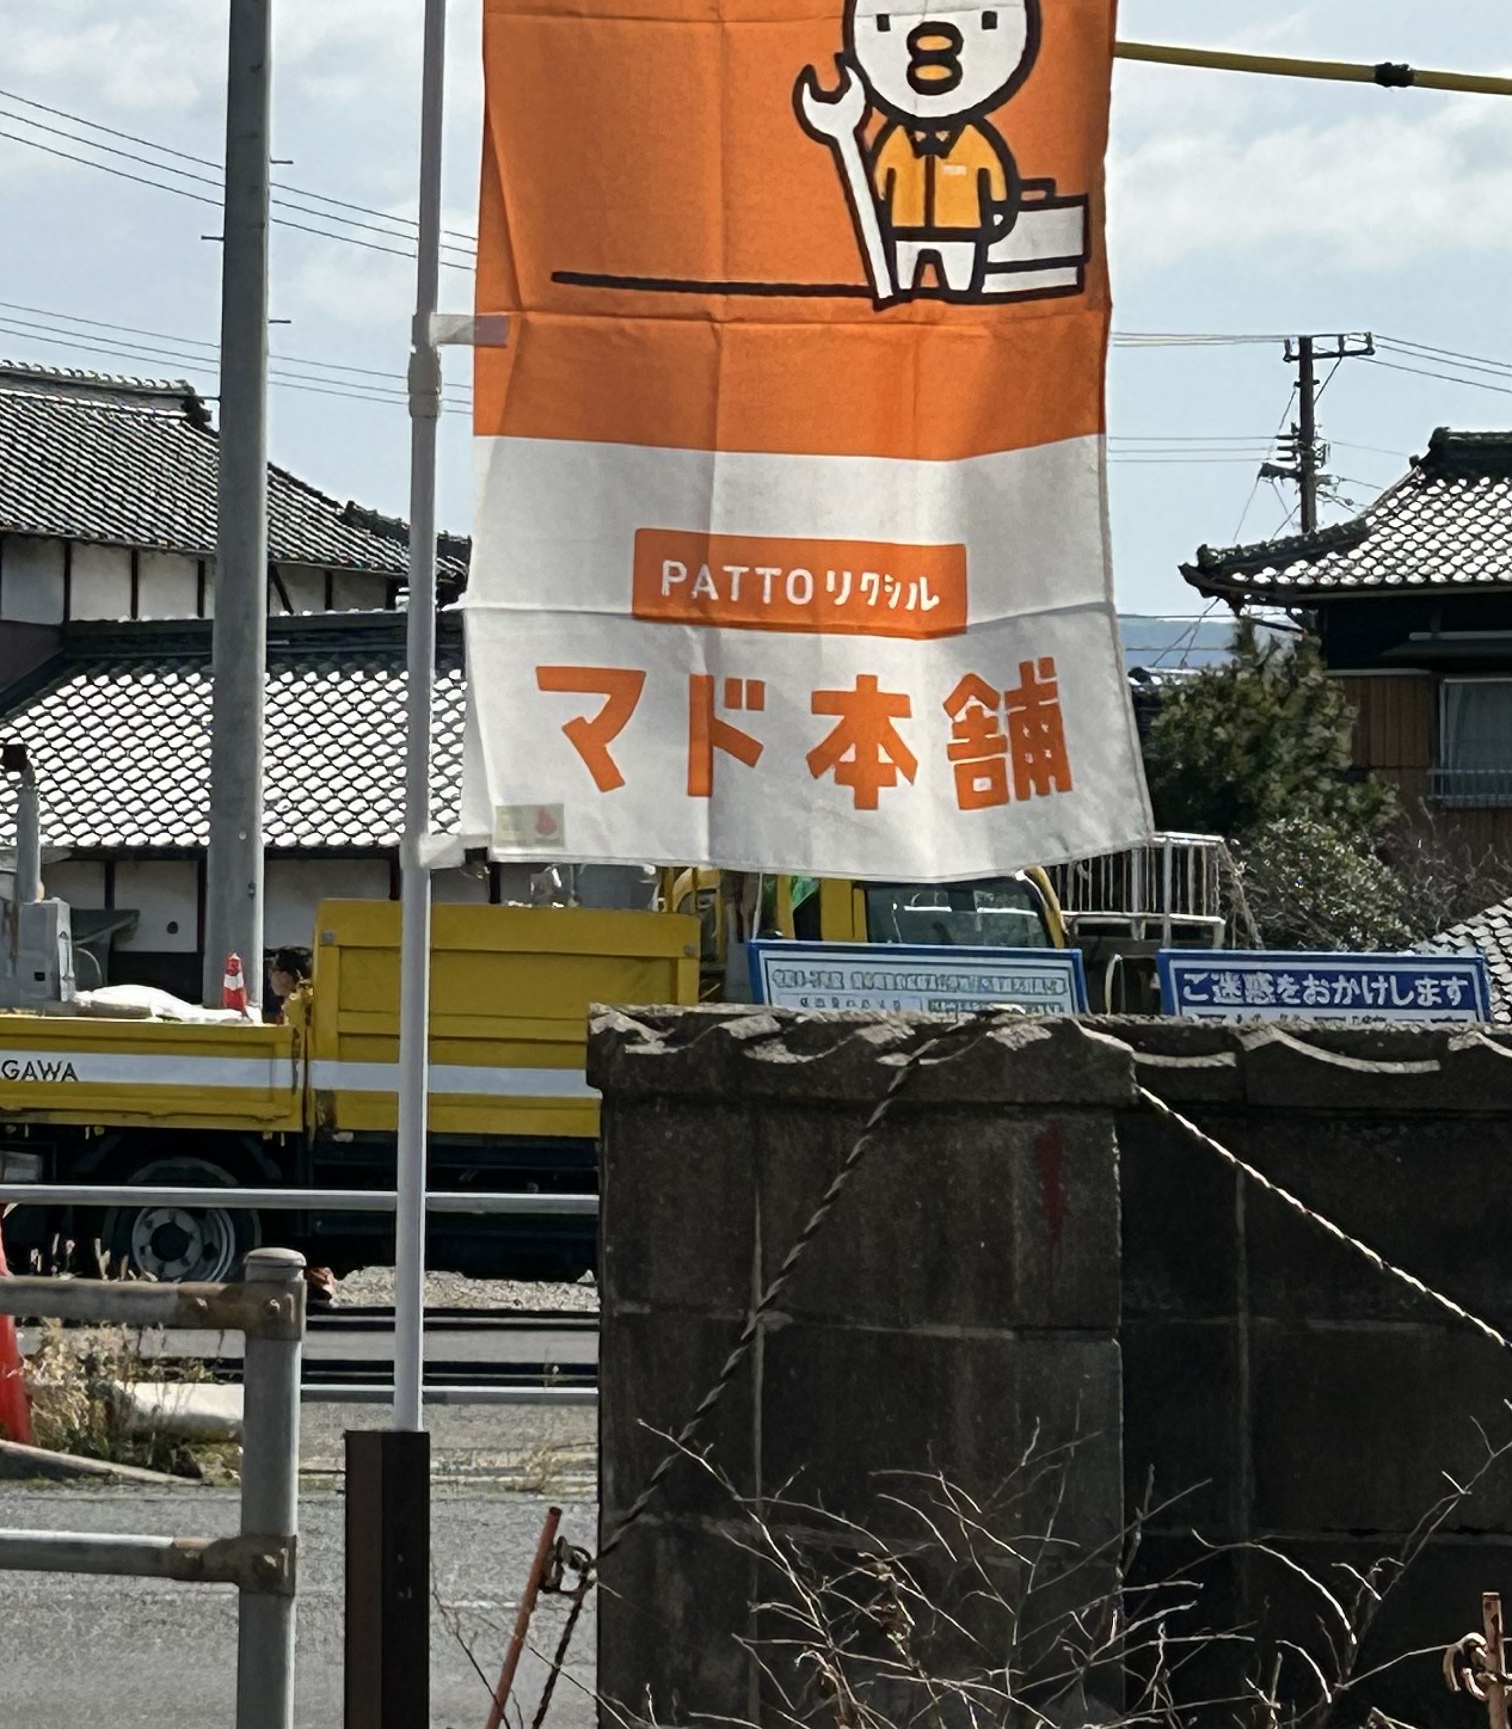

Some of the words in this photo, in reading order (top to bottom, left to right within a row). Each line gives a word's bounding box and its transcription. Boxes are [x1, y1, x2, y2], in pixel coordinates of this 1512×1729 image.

[536, 657, 1073, 813] マド本舗
[1183, 971, 1469, 1007] ご迷惑をおかけします
